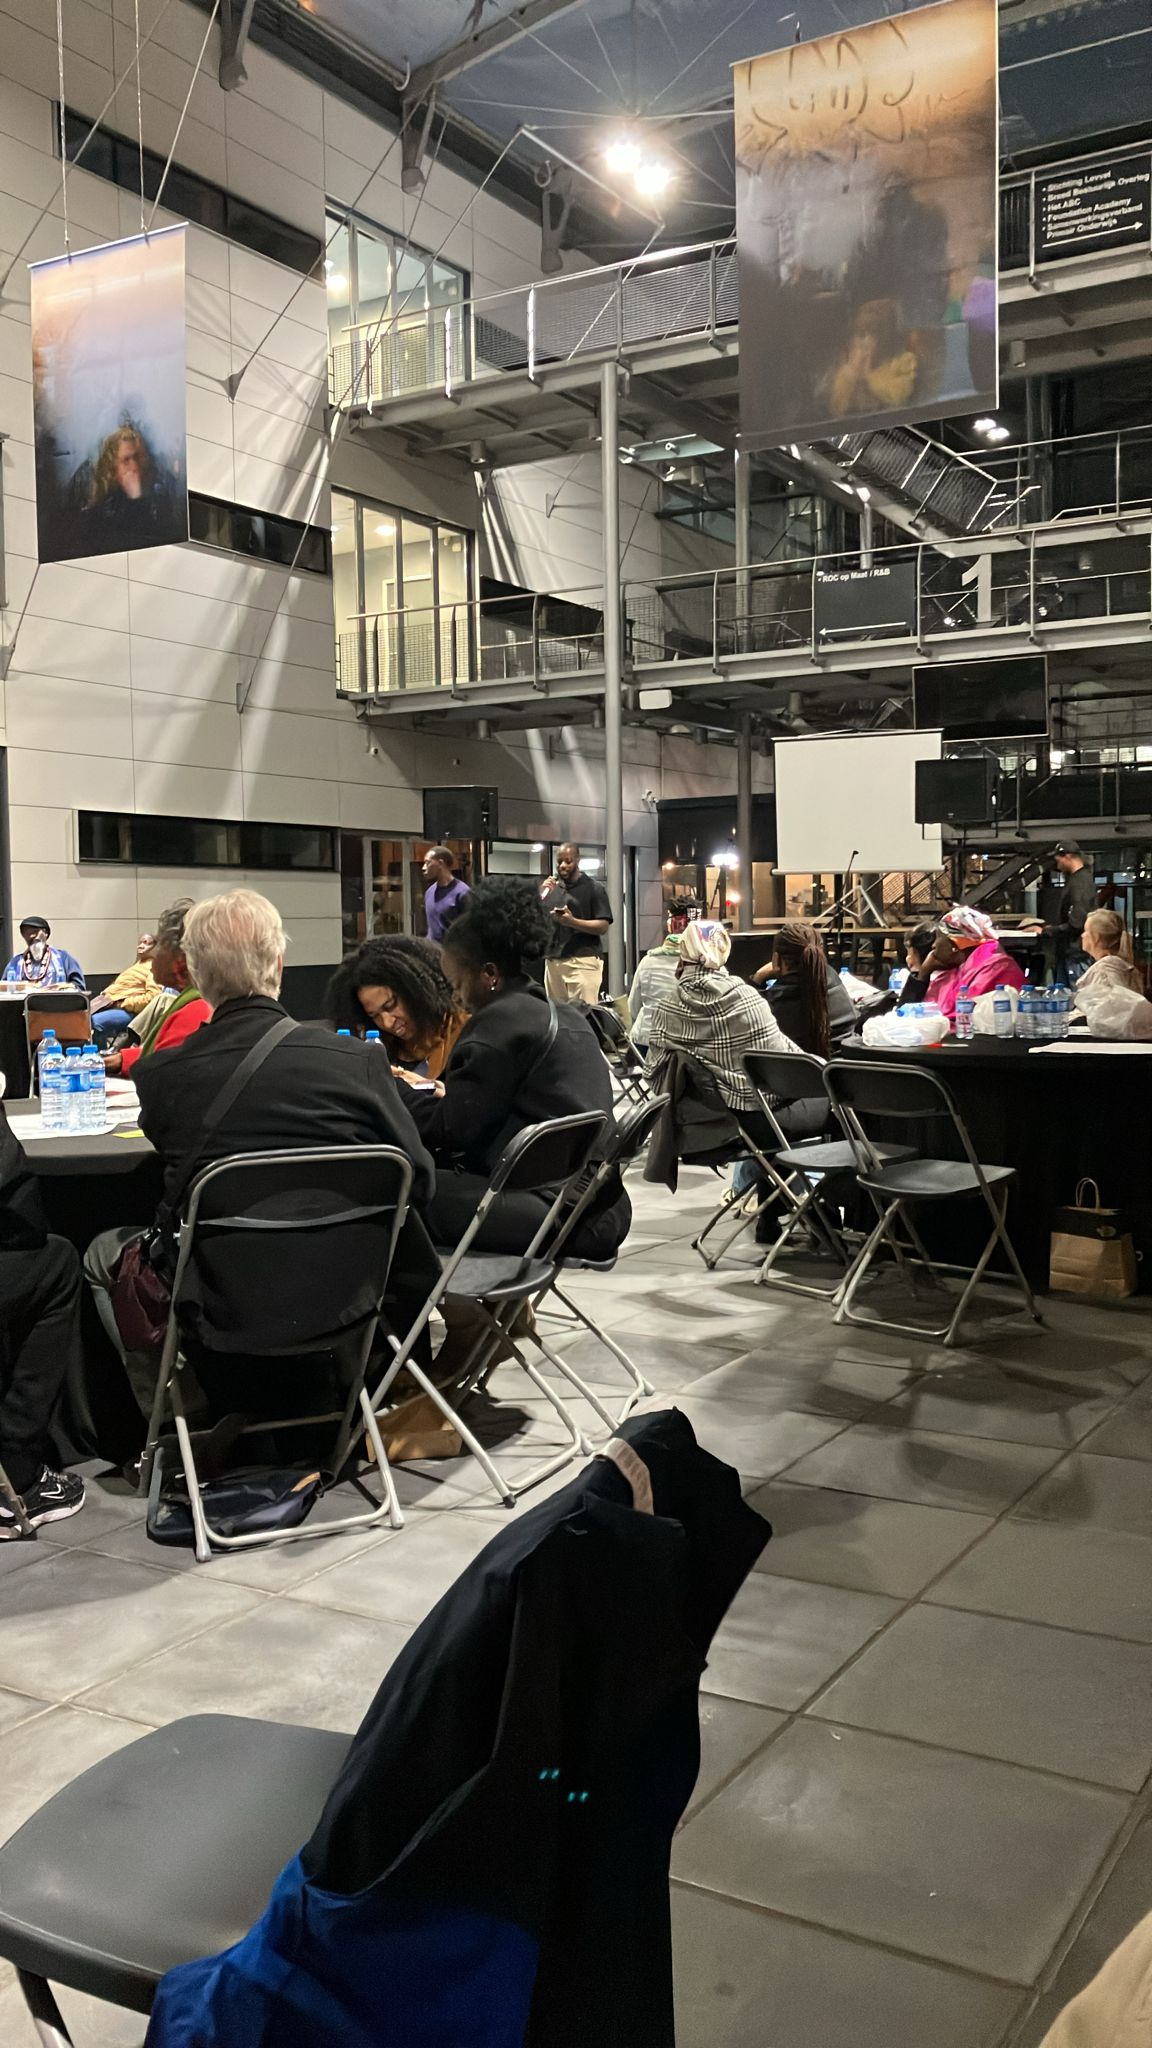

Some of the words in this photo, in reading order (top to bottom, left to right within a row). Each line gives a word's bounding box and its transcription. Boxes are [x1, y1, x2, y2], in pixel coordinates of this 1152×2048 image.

[1117, 173, 1150, 186] Overleg
[1047, 202, 1062, 212] Het
[1062, 198, 1081, 209] ABC
[1047, 207, 1093, 222] Foundation
[1093, 198, 1131, 212] Academy
[1047, 203, 1143, 231] Samenwerkingsverband
[1076, 218, 1118, 233] Onderwijs
[822, 574, 839, 583] ROC
[840, 573, 850, 581] op
[850, 570, 868, 579] Maat
[873, 567, 891, 577] R&B
[961, 553, 992, 622] 1
